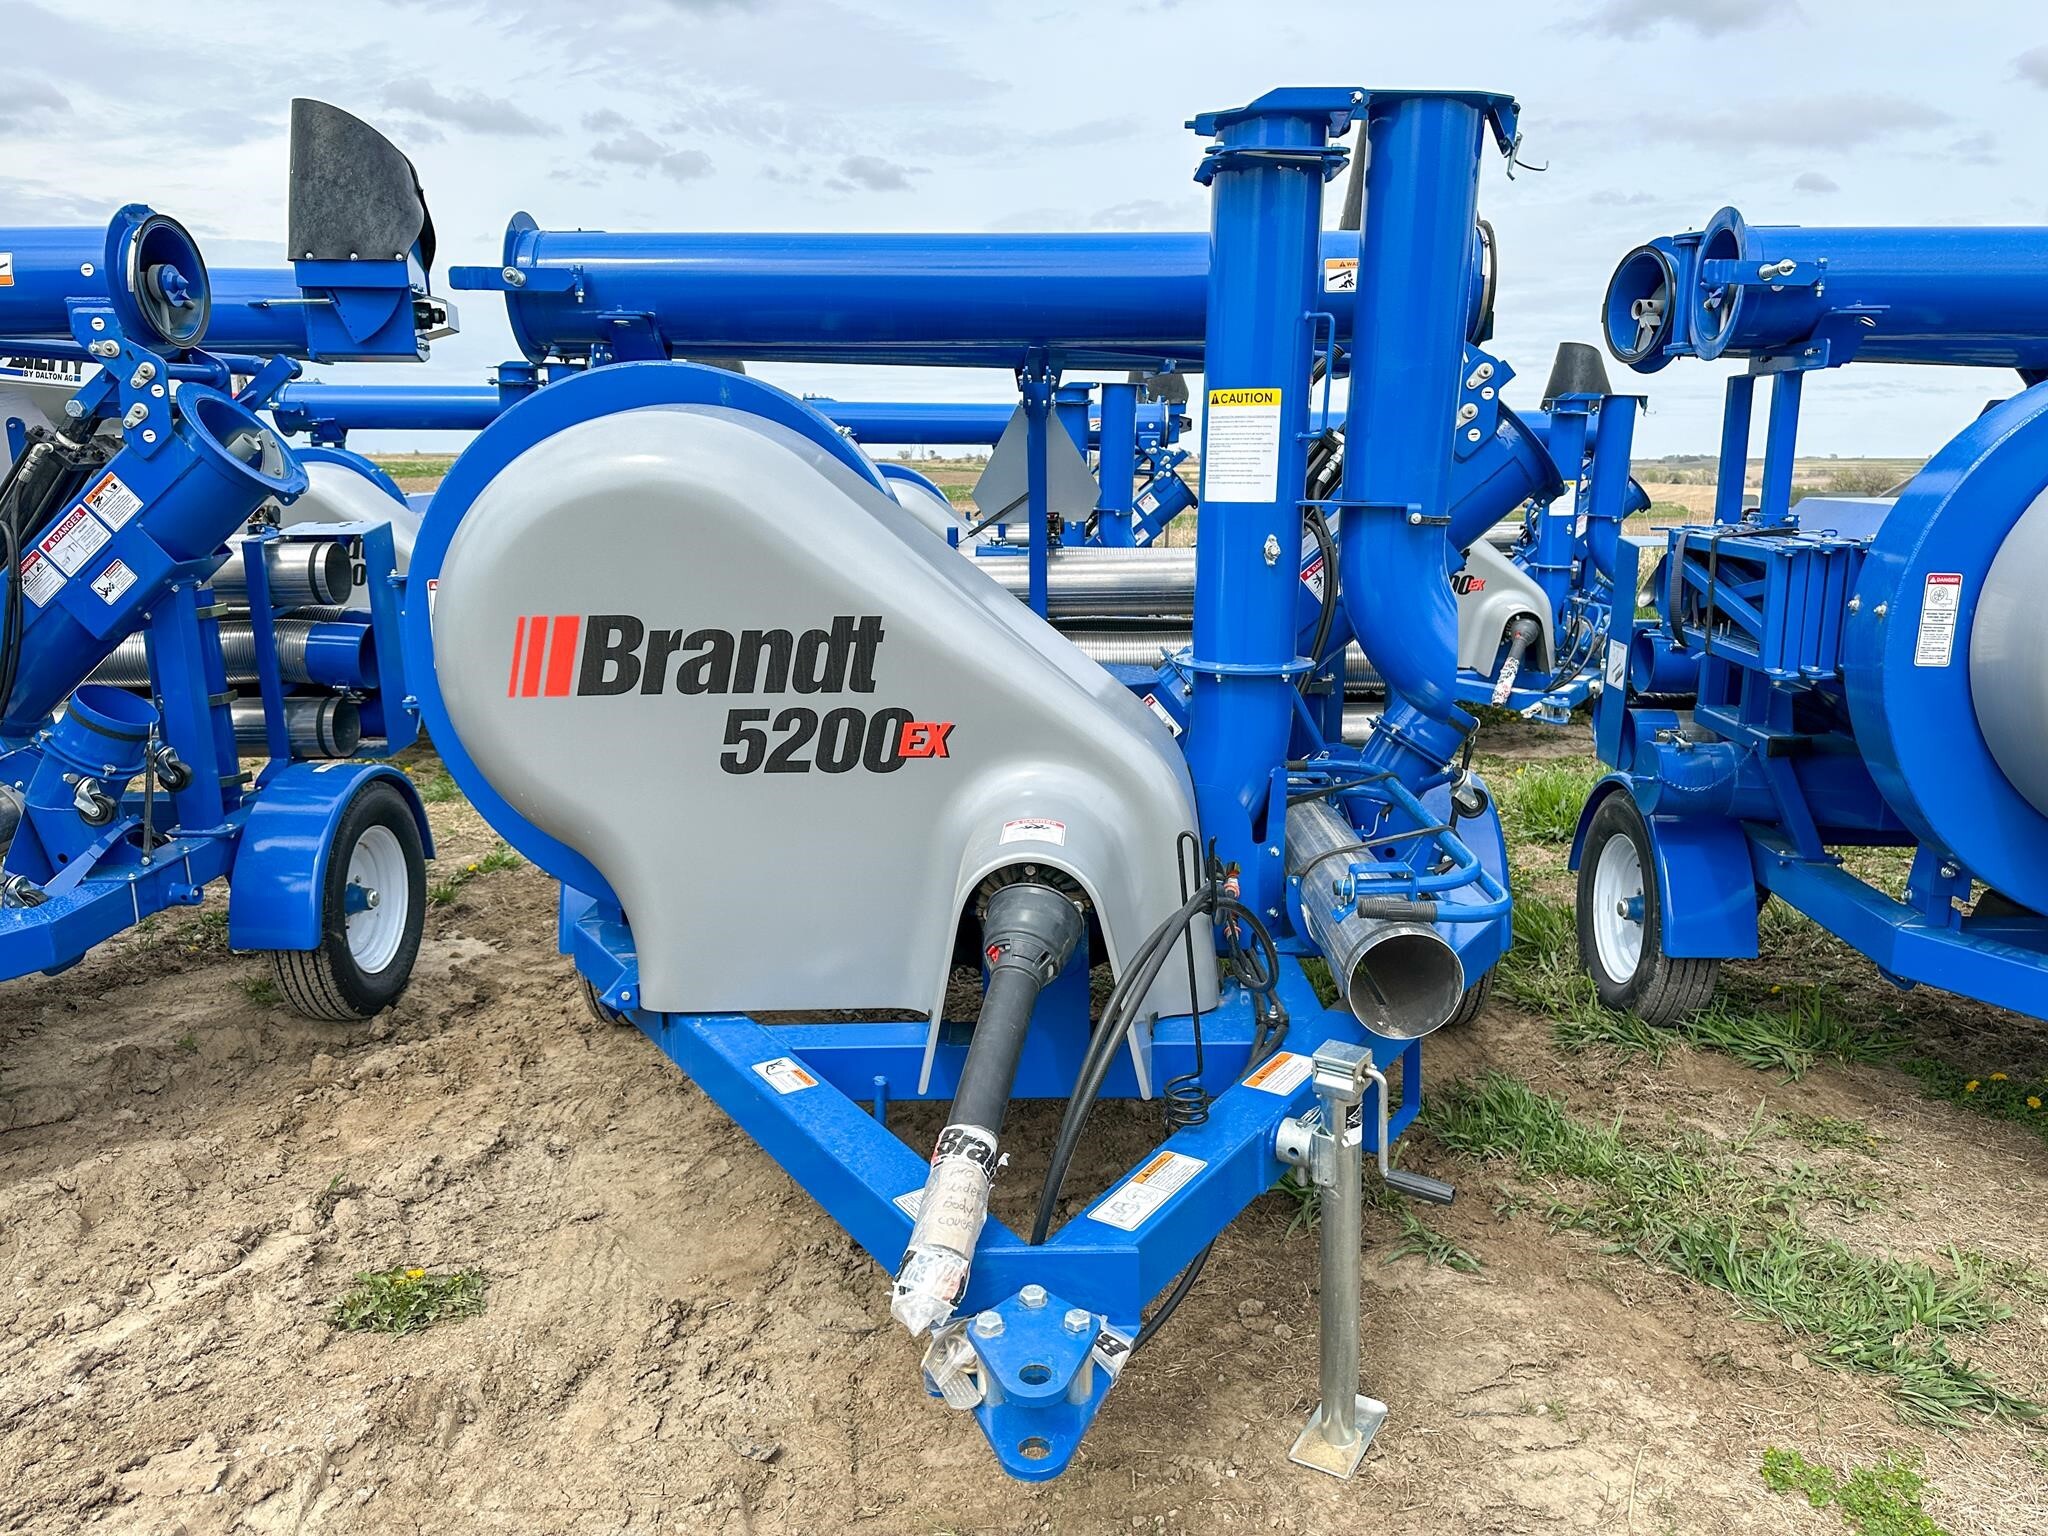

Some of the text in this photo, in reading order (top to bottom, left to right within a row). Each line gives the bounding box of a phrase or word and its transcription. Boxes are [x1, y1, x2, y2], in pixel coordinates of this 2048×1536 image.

[23, 369, 74, 382] BY DALTON AG
[1220, 392, 1273, 404] CAUTION
[52, 512, 82, 542] DANGER
[577, 615, 885, 697] Brandt
